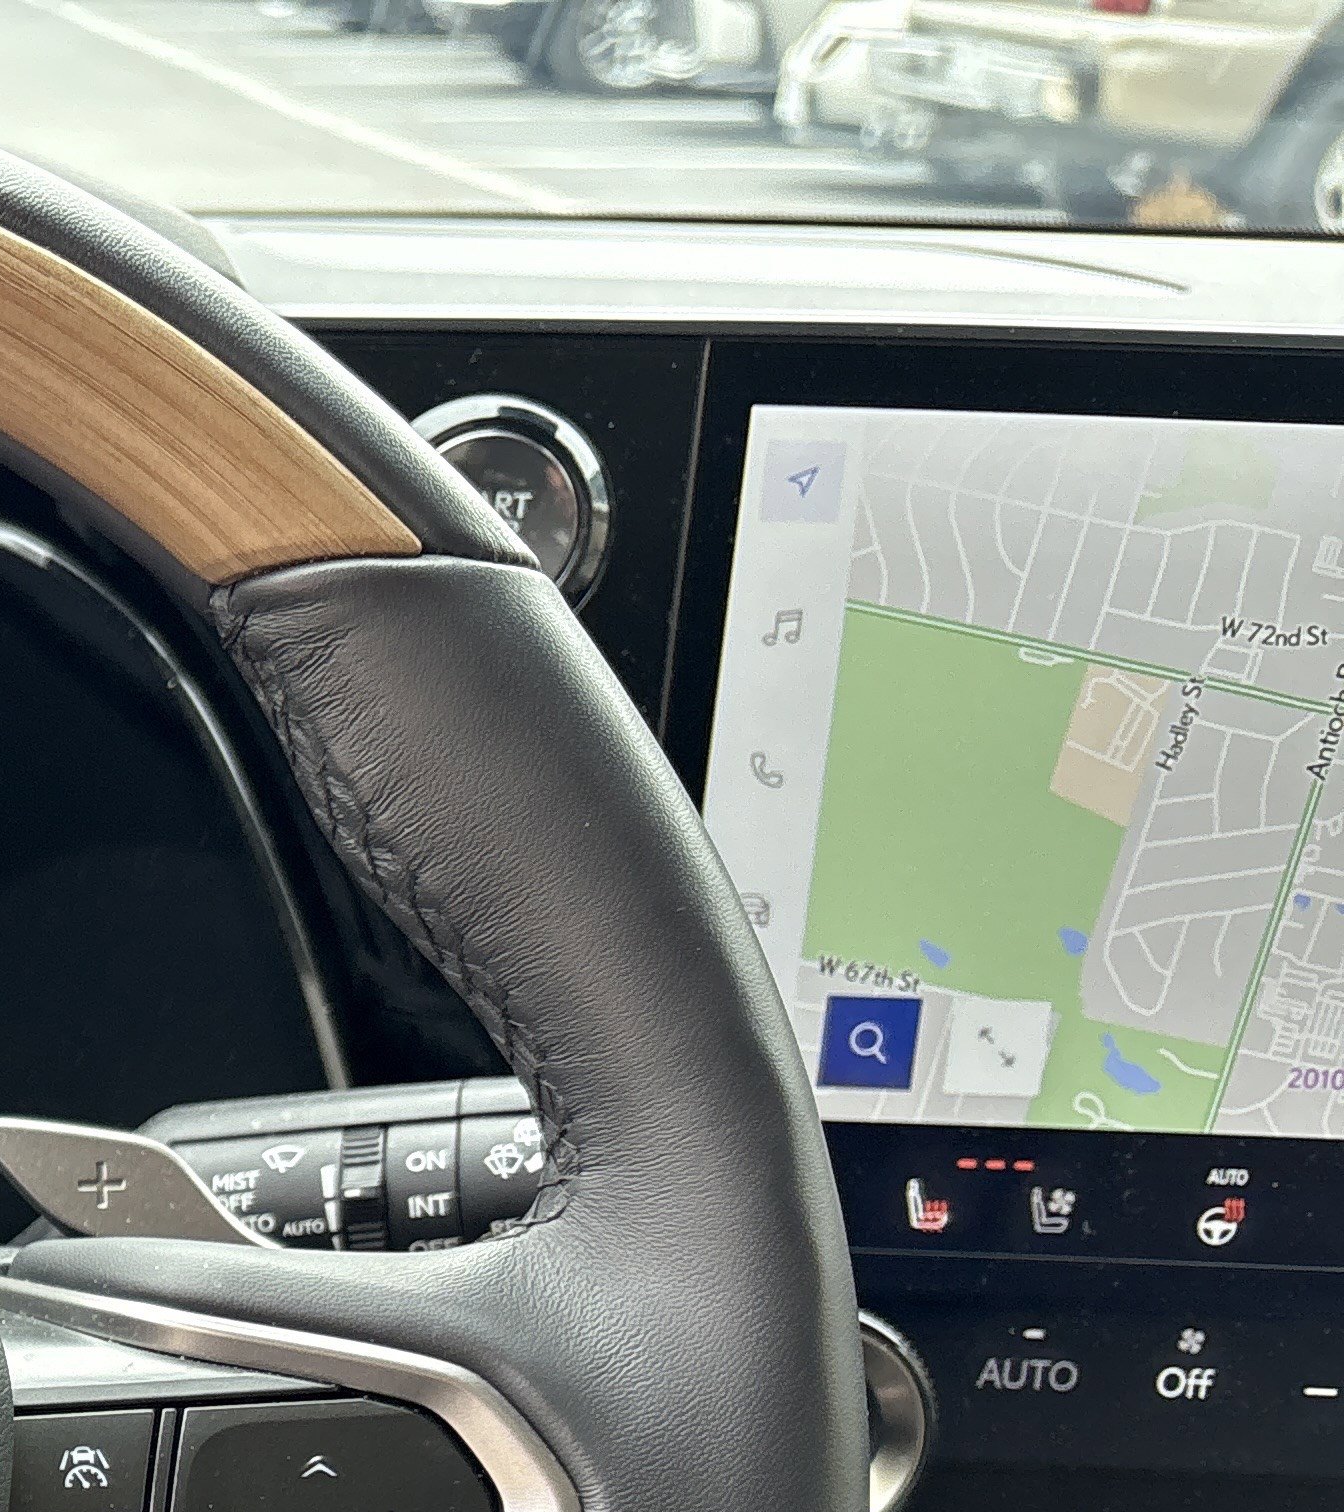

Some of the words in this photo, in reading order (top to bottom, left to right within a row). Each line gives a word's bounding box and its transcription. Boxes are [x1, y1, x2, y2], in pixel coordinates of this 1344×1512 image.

[1221, 616, 1244, 638] W
[1247, 621, 1301, 647] 72nd
[1306, 625, 1328, 646] St
[1155, 703, 1199, 772] Hadley
[1181, 676, 1206, 700] St
[820, 955, 841, 976] W
[844, 961, 894, 989] 67th
[897, 968, 920, 993] St
[405, 1149, 448, 1172] ON
[212, 1169, 261, 1193] MIST
[1207, 1167, 1248, 1187] AUTO
[408, 1192, 453, 1218] INT
[283, 1217, 325, 1238] AUTO
[976, 1358, 1078, 1391] AUTO
[1155, 1366, 1217, 1400] Off
